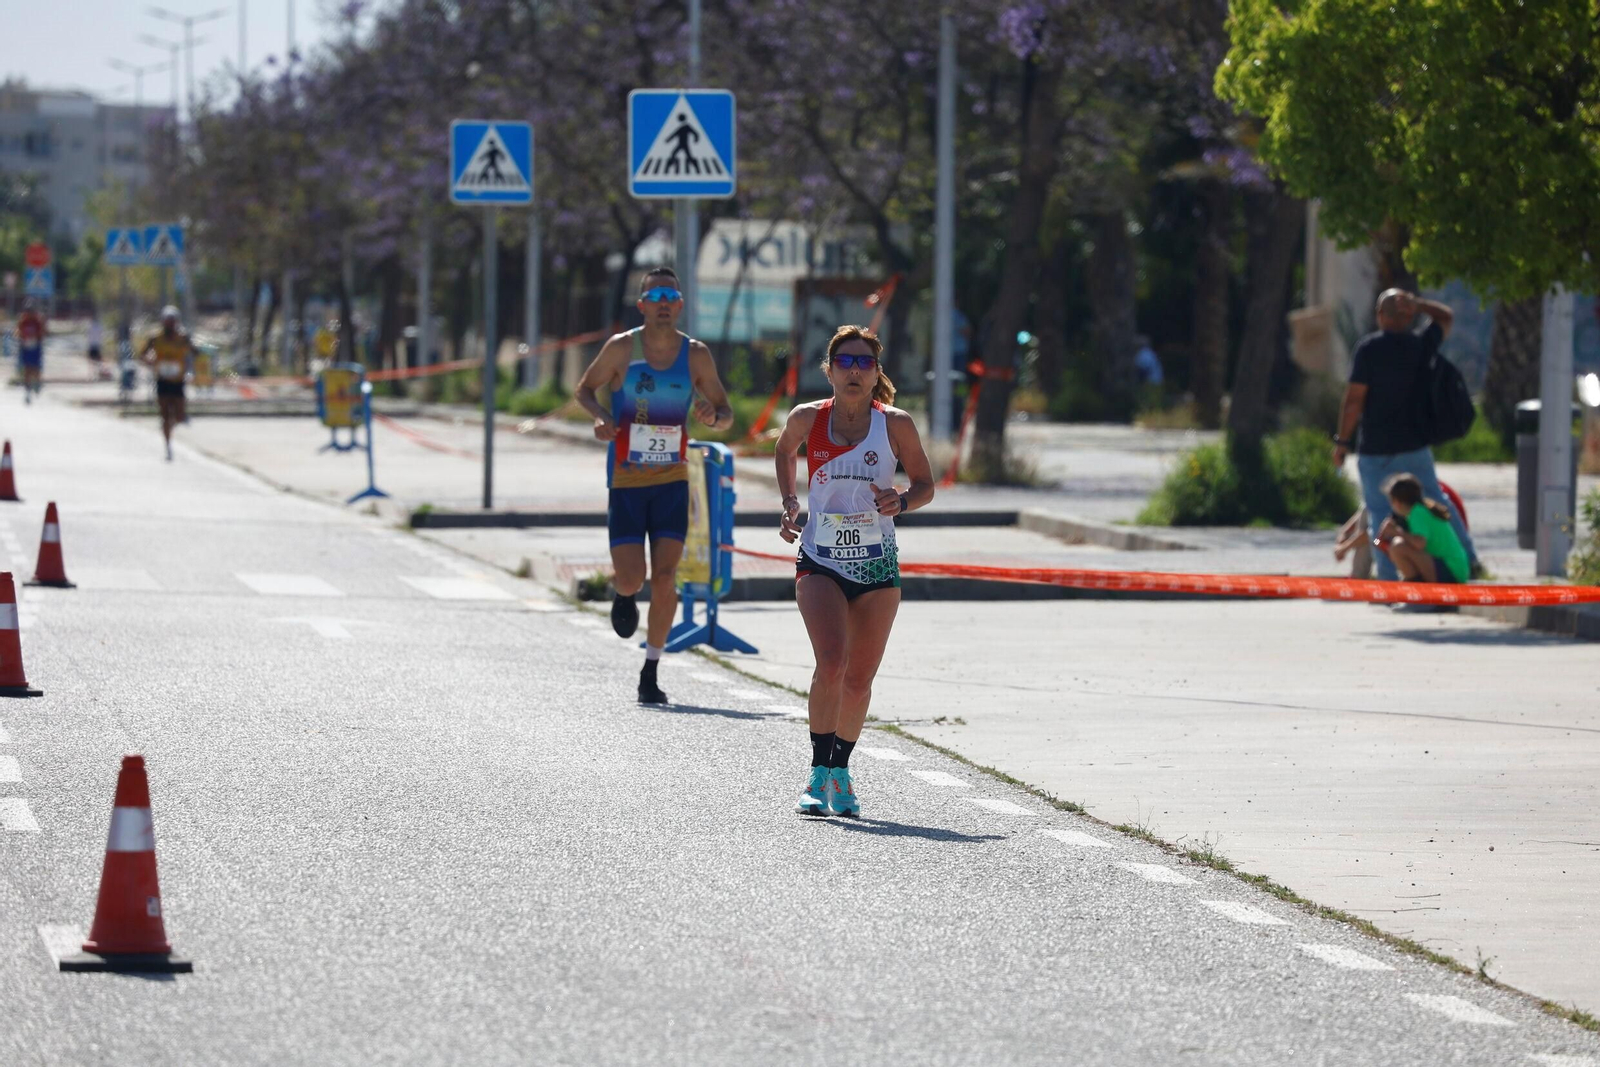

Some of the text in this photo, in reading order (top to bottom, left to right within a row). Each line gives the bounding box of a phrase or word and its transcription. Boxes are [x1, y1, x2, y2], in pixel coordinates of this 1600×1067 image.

[648, 438, 666, 452] 23
[835, 529, 860, 546] 206
[829, 547, 869, 559] Joma
